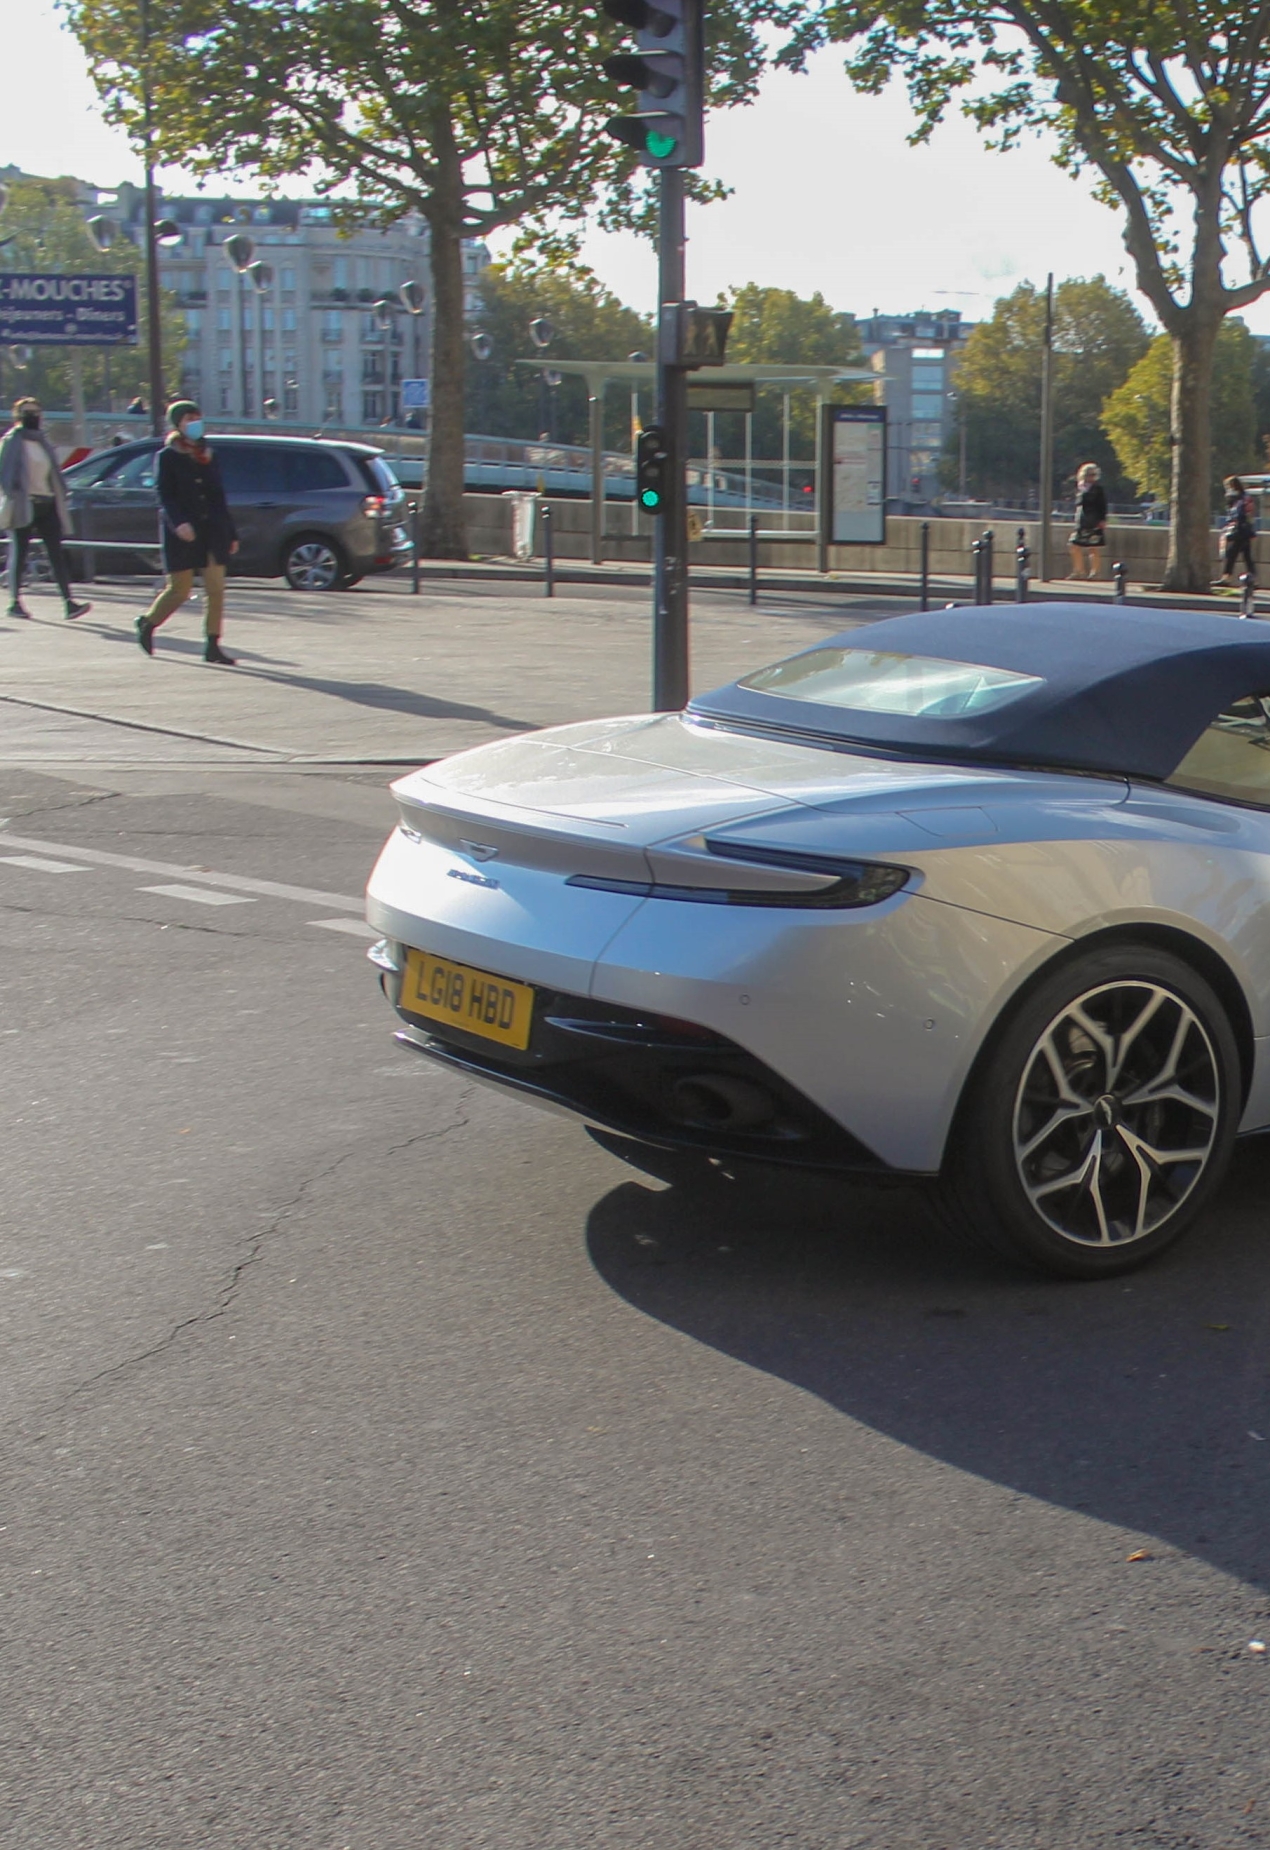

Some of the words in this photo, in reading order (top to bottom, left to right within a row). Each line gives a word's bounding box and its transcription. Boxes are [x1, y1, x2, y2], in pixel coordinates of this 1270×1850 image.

[0, 279, 125, 301] -MOUCHES
[416, 960, 465, 1013] LG18
[468, 978, 515, 1030] HBD
